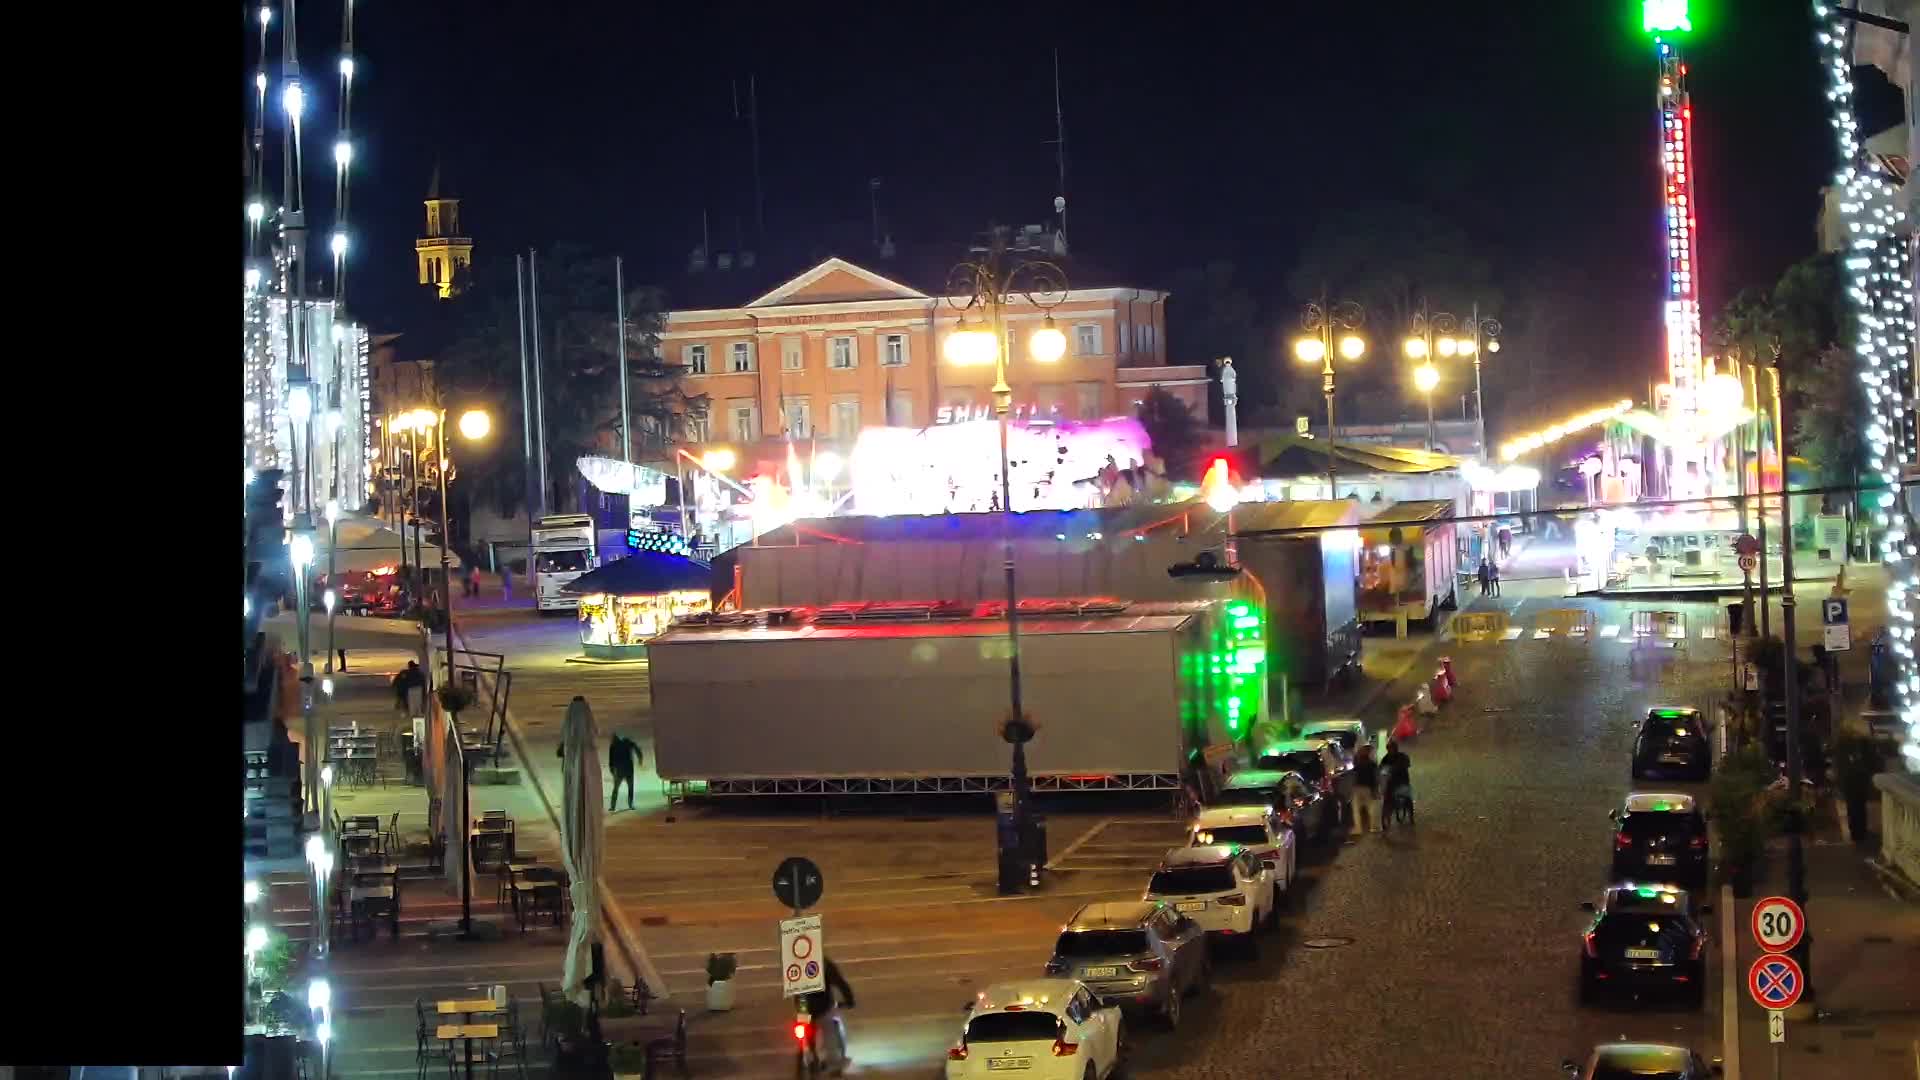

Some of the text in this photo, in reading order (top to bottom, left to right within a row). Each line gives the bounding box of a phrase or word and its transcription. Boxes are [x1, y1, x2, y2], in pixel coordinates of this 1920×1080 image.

[1743, 558, 1753, 566] 20
[1827, 602, 1842, 623] P
[1762, 912, 1791, 938] 30
